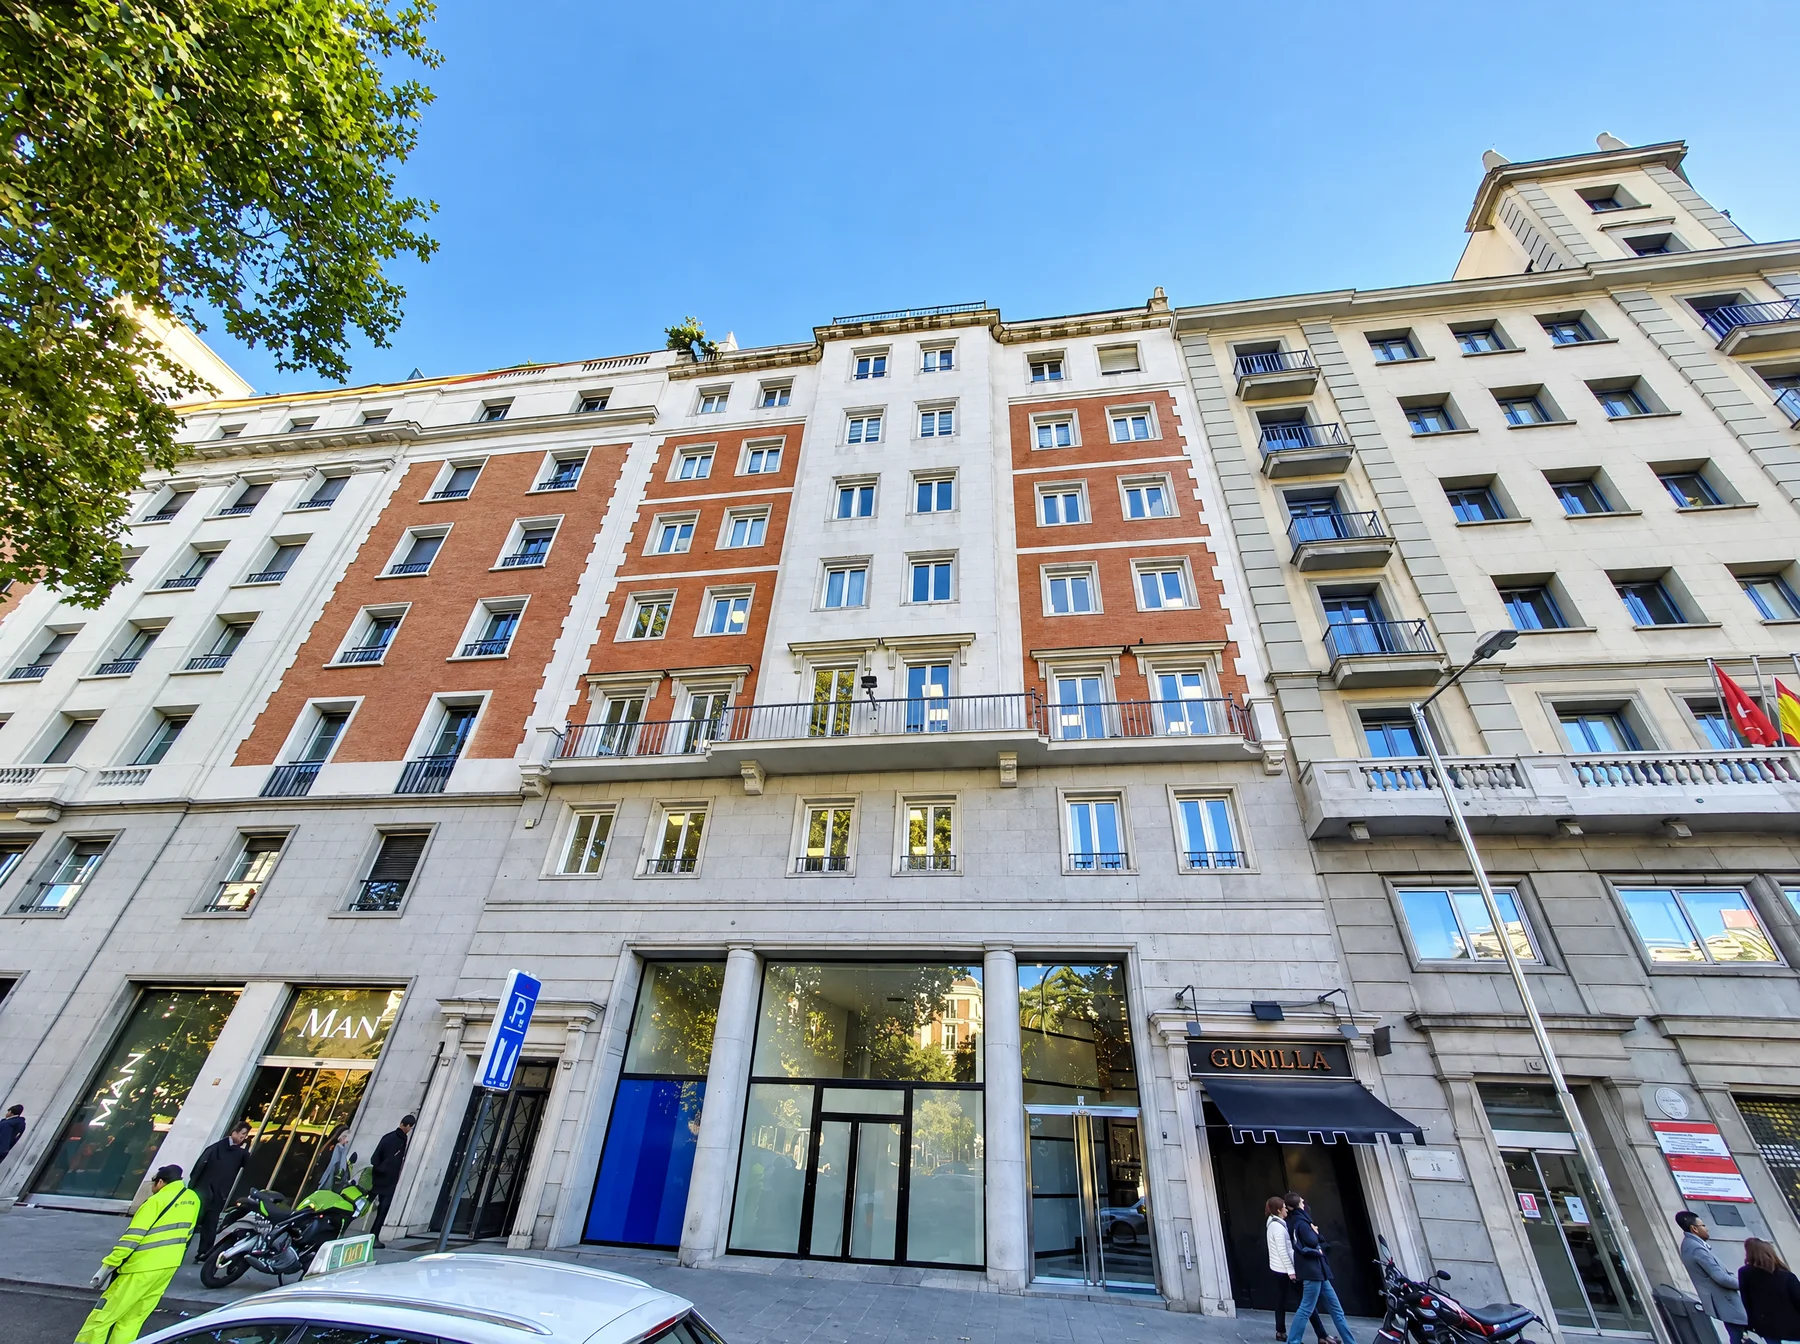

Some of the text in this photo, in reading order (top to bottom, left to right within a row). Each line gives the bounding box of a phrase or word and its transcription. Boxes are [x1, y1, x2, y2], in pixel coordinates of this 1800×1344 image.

[297, 1008, 382, 1039] MAN
[1210, 1048, 1332, 1069] GUNILLA
[89, 1053, 145, 1127] MAN
